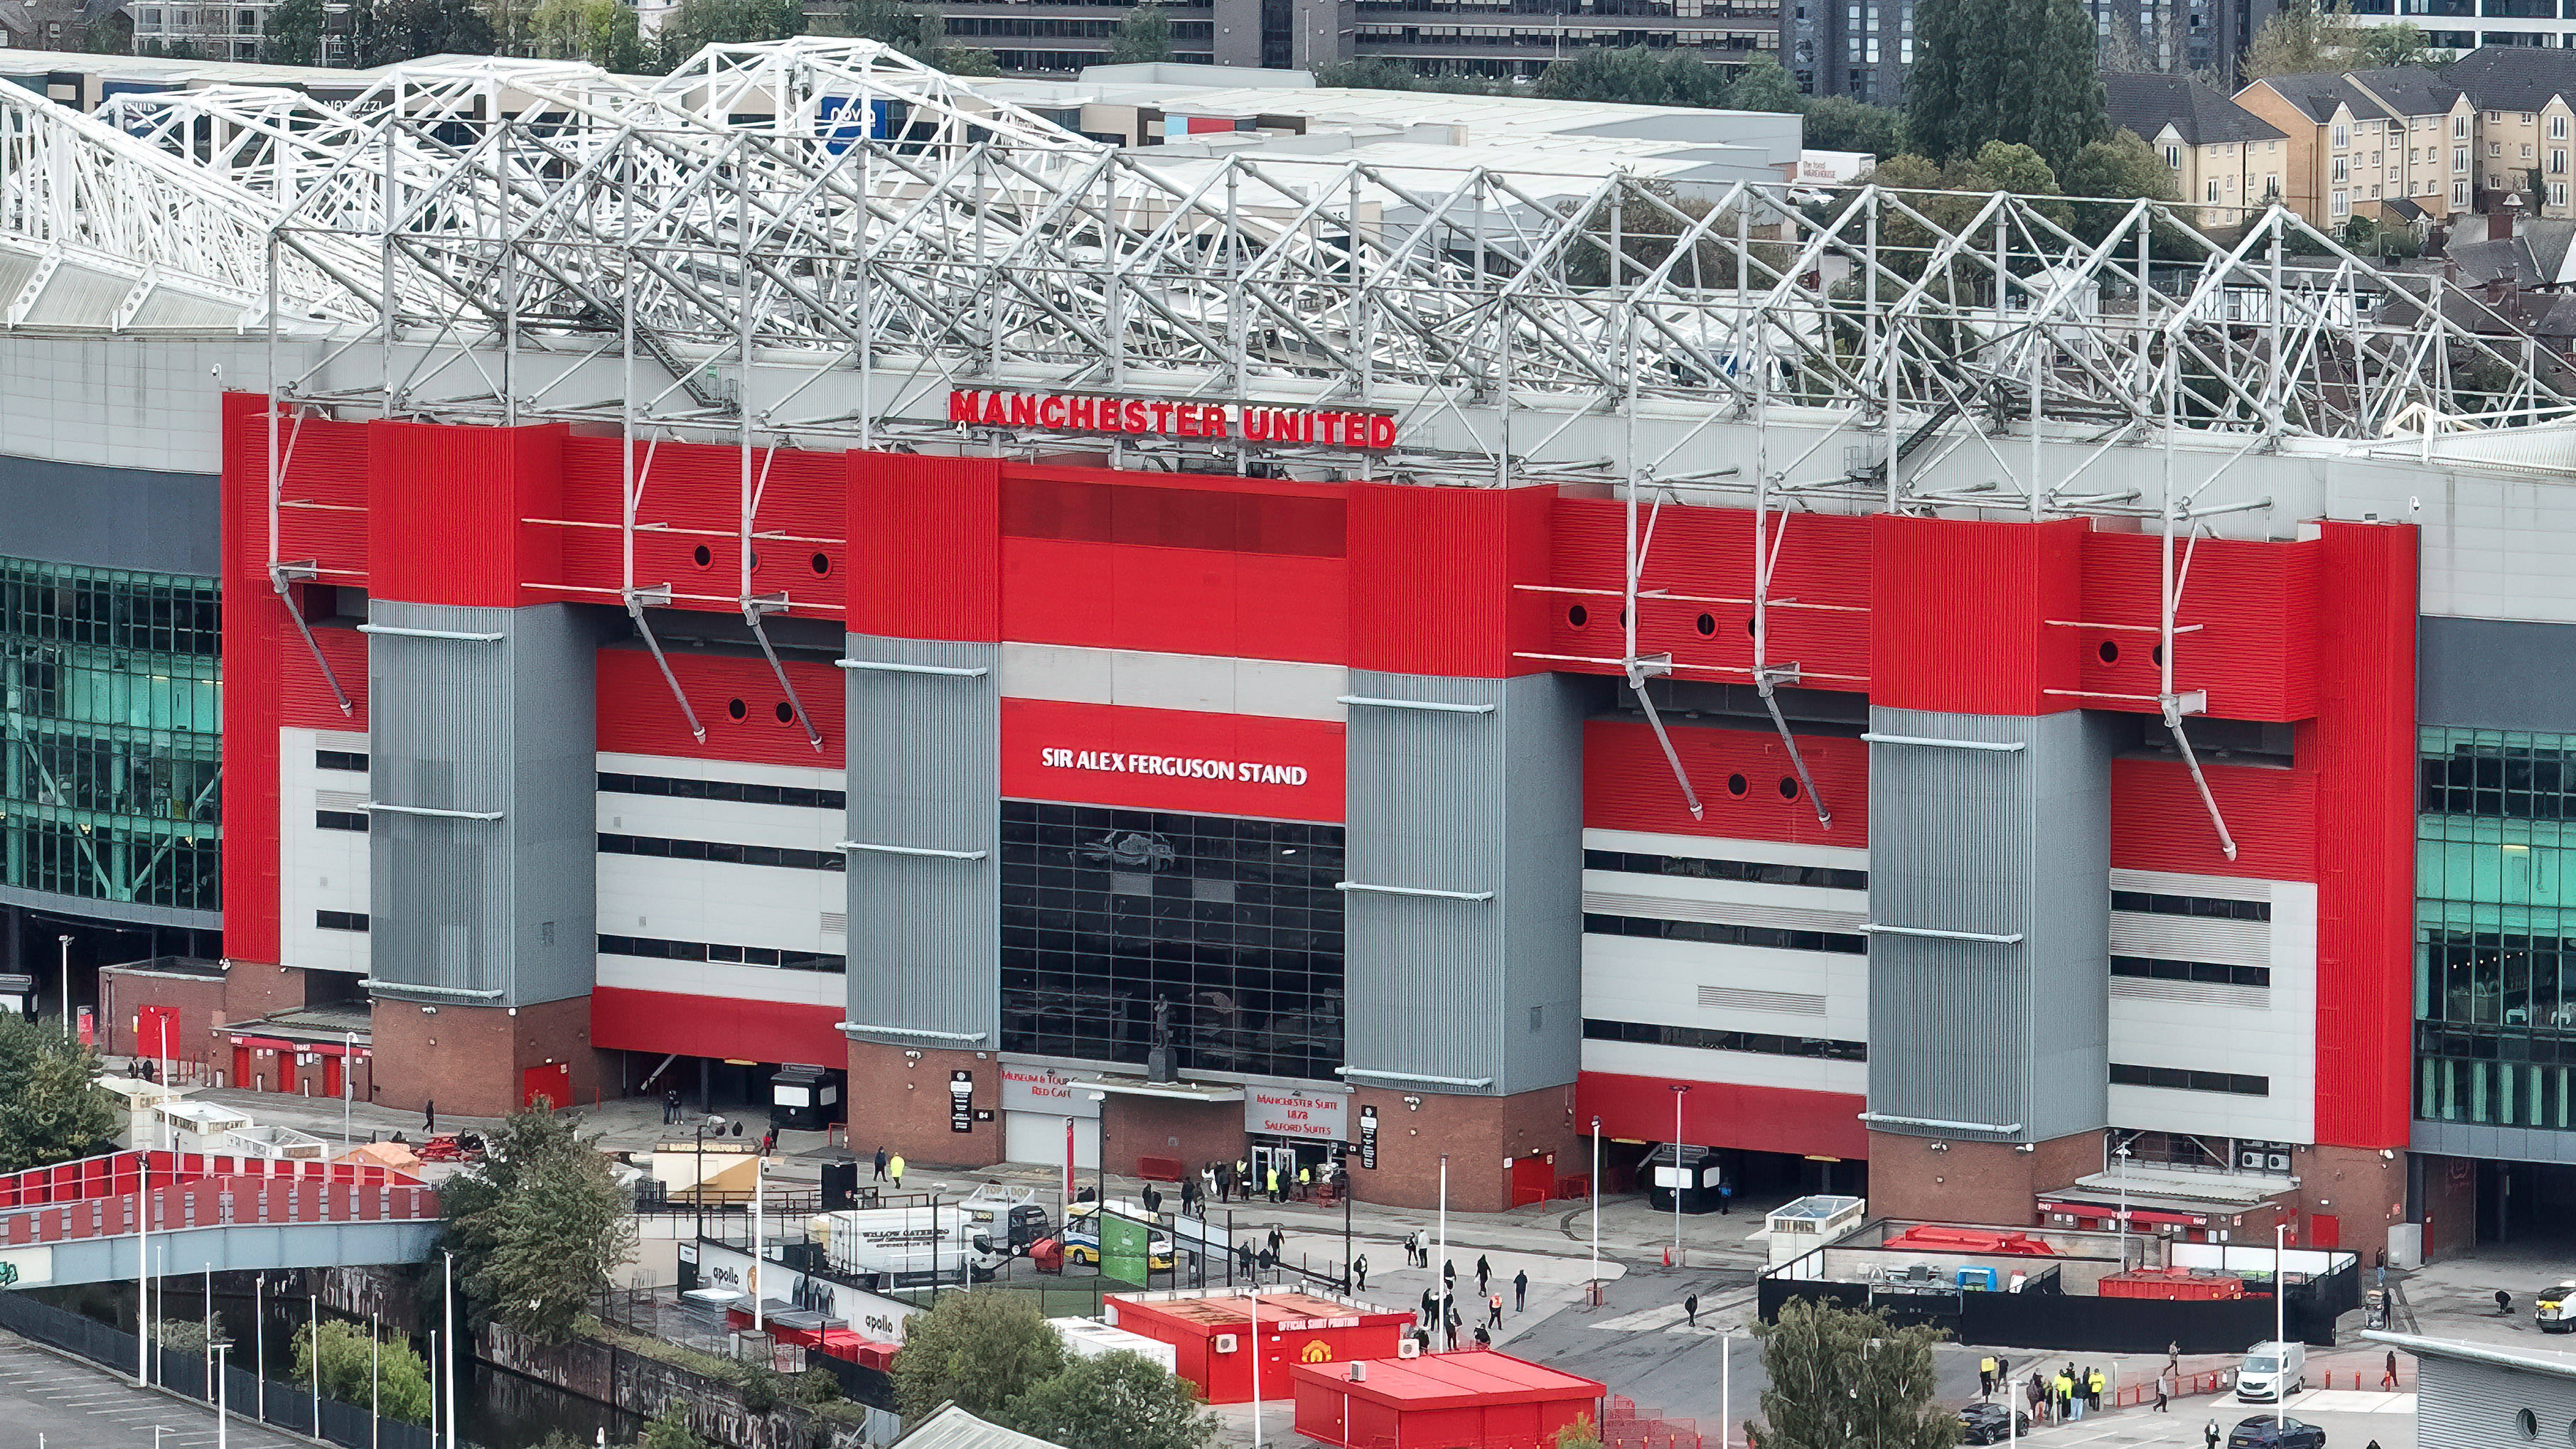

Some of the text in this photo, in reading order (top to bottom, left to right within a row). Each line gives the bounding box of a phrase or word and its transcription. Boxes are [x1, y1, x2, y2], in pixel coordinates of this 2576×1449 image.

[950, 390, 1398, 448] MANCHESTER UNITED
[1041, 748, 1309, 786] SIR ALEX FERGUSON STAND
[713, 1266, 739, 1285] apollo
[866, 1315, 893, 1333] apollo
